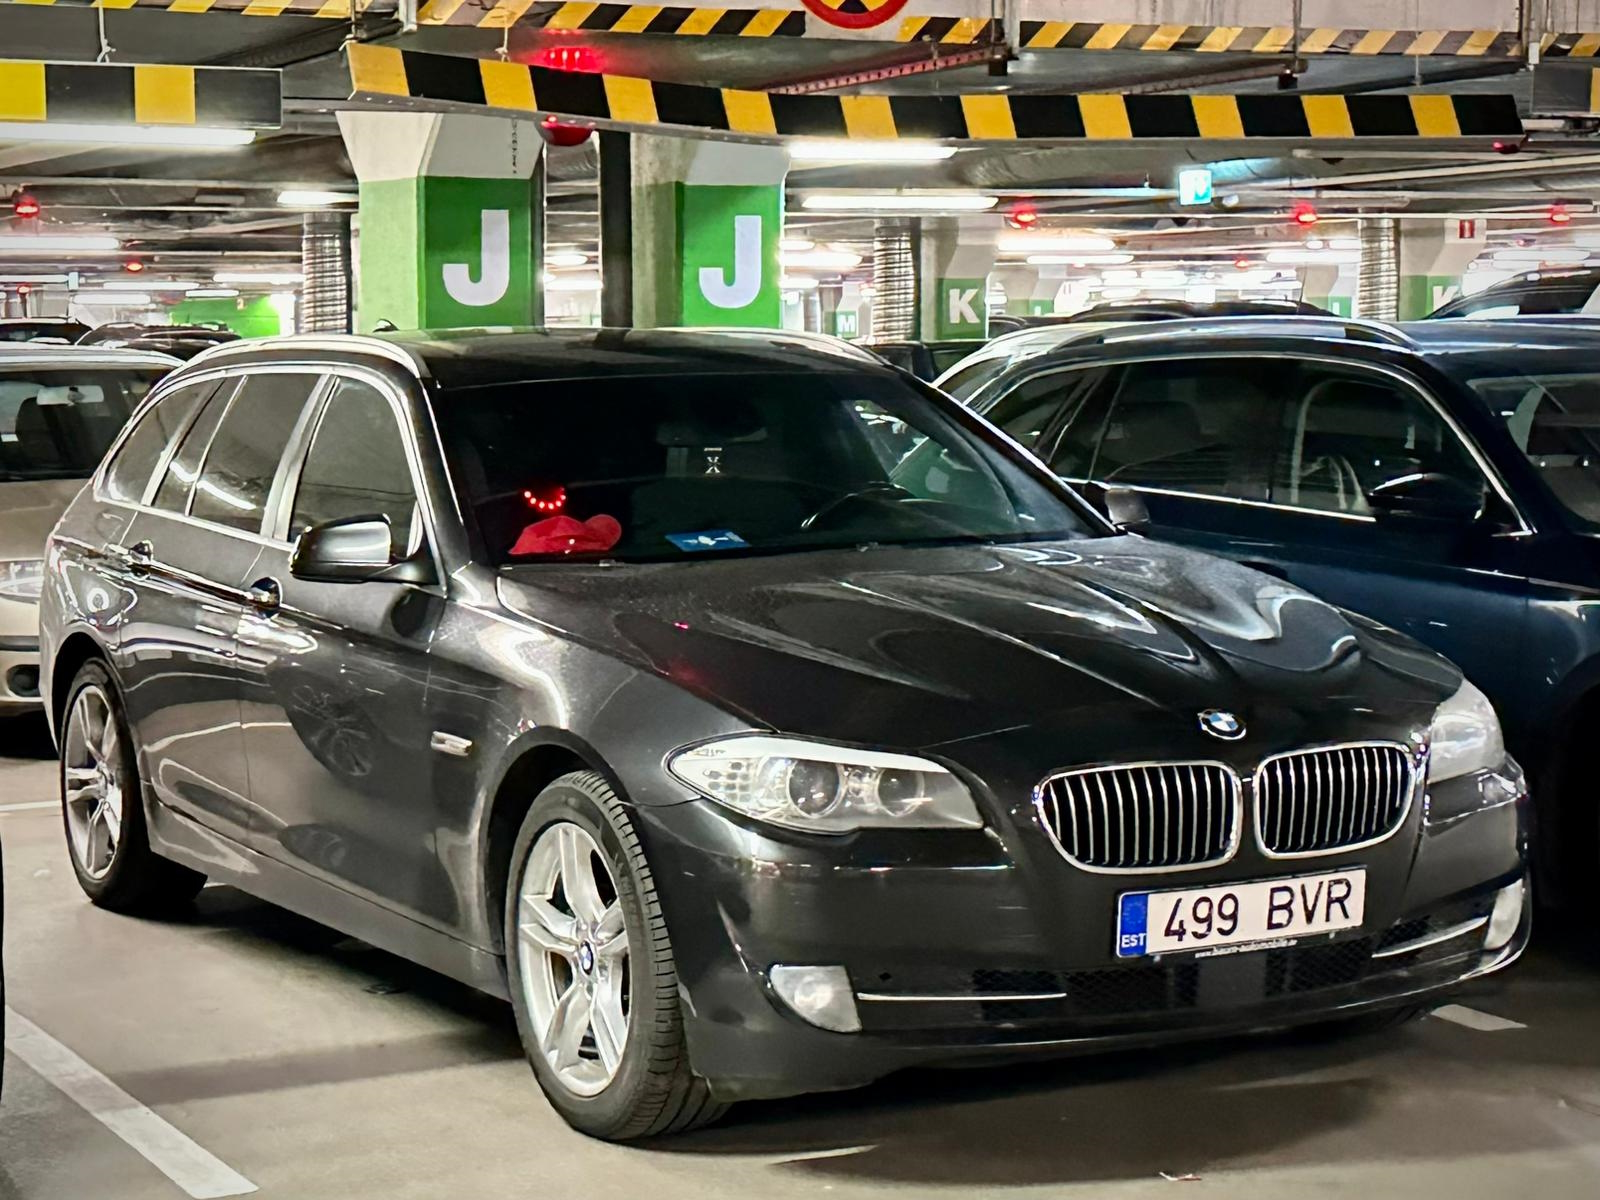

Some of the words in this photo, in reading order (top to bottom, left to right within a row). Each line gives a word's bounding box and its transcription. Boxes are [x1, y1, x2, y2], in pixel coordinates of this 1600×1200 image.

[443, 210, 510, 306] J
[698, 215, 762, 308] J
[838, 315, 856, 332] M
[949, 288, 980, 324] K
[1163, 893, 1239, 942] 499
[1267, 877, 1352, 930] BVR
[1121, 932, 1147, 949] EST
